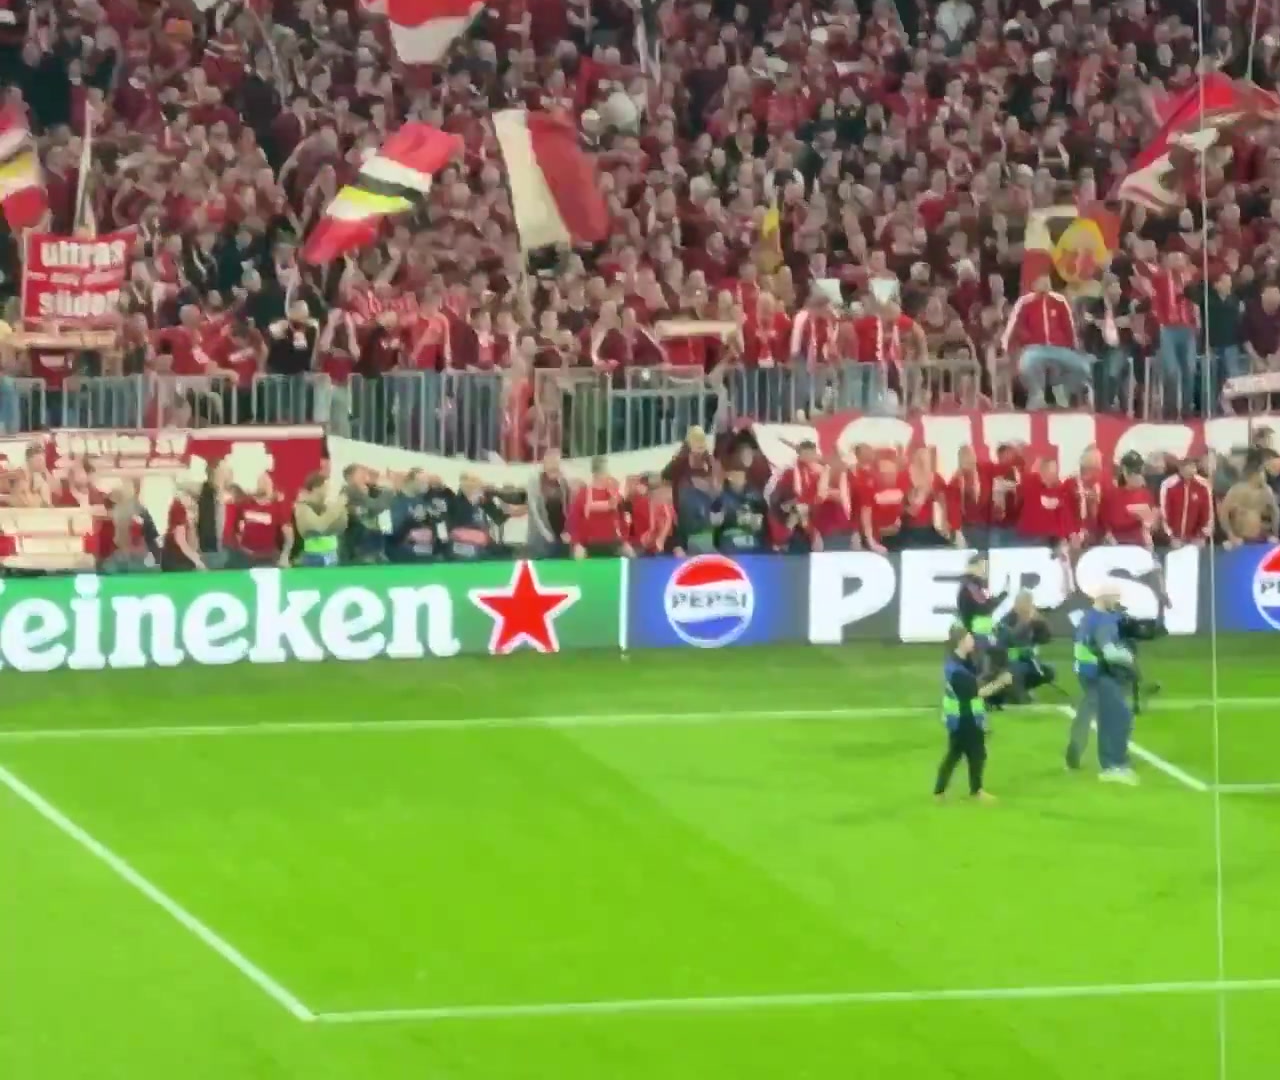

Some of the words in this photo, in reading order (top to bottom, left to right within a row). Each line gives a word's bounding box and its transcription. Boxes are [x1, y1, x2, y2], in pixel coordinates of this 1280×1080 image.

[0, 568, 461, 672] eineken
[672, 590, 748, 614] PEPSI
[809, 546, 1201, 645] PEPSI
